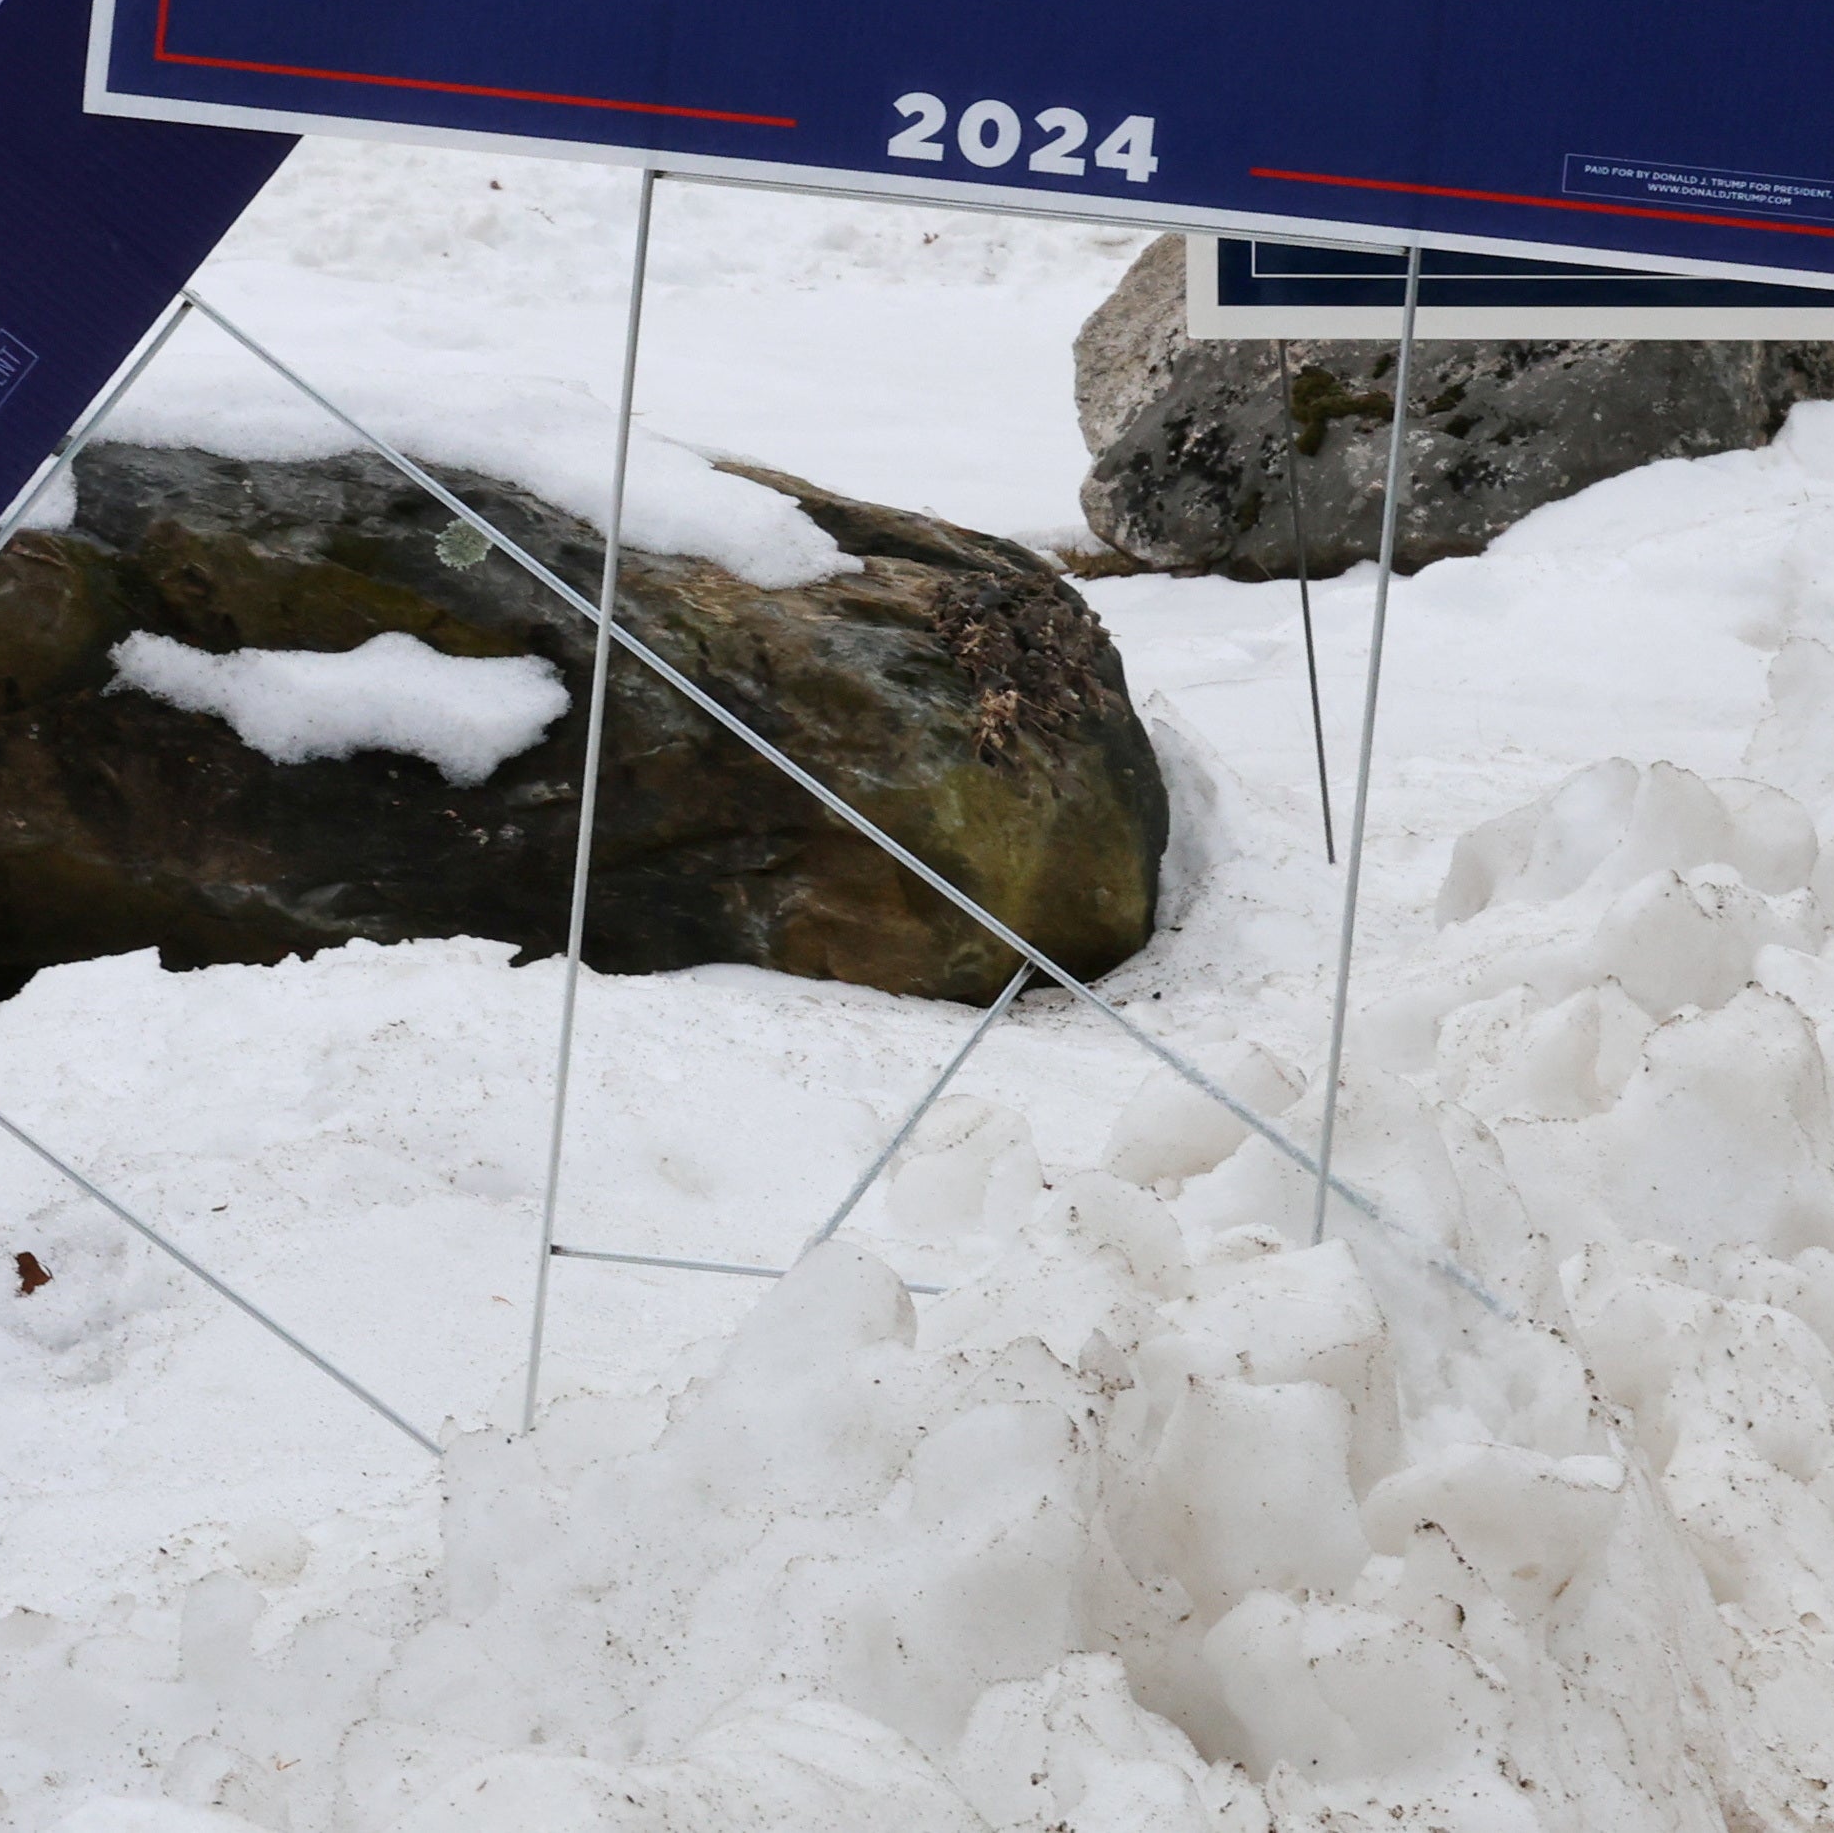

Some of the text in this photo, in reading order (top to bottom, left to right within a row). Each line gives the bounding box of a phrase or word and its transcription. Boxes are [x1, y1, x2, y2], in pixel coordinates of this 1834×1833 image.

[888, 93, 1158, 182] 2024
[1584, 164, 1609, 176] PAID
[1611, 167, 1634, 178] FOR
[1636, 170, 1652, 179] BY
[1652, 171, 1698, 185] DONALD
[1699, 177, 1709, 186] J.
[1710, 178, 1747, 189] TRUMP
[1749, 182, 1772, 192] FOR
[1773, 184, 1833, 199] PRESIDENT,
[1647, 183, 1792, 206] WWW.DONALDJTRUMP.COM
